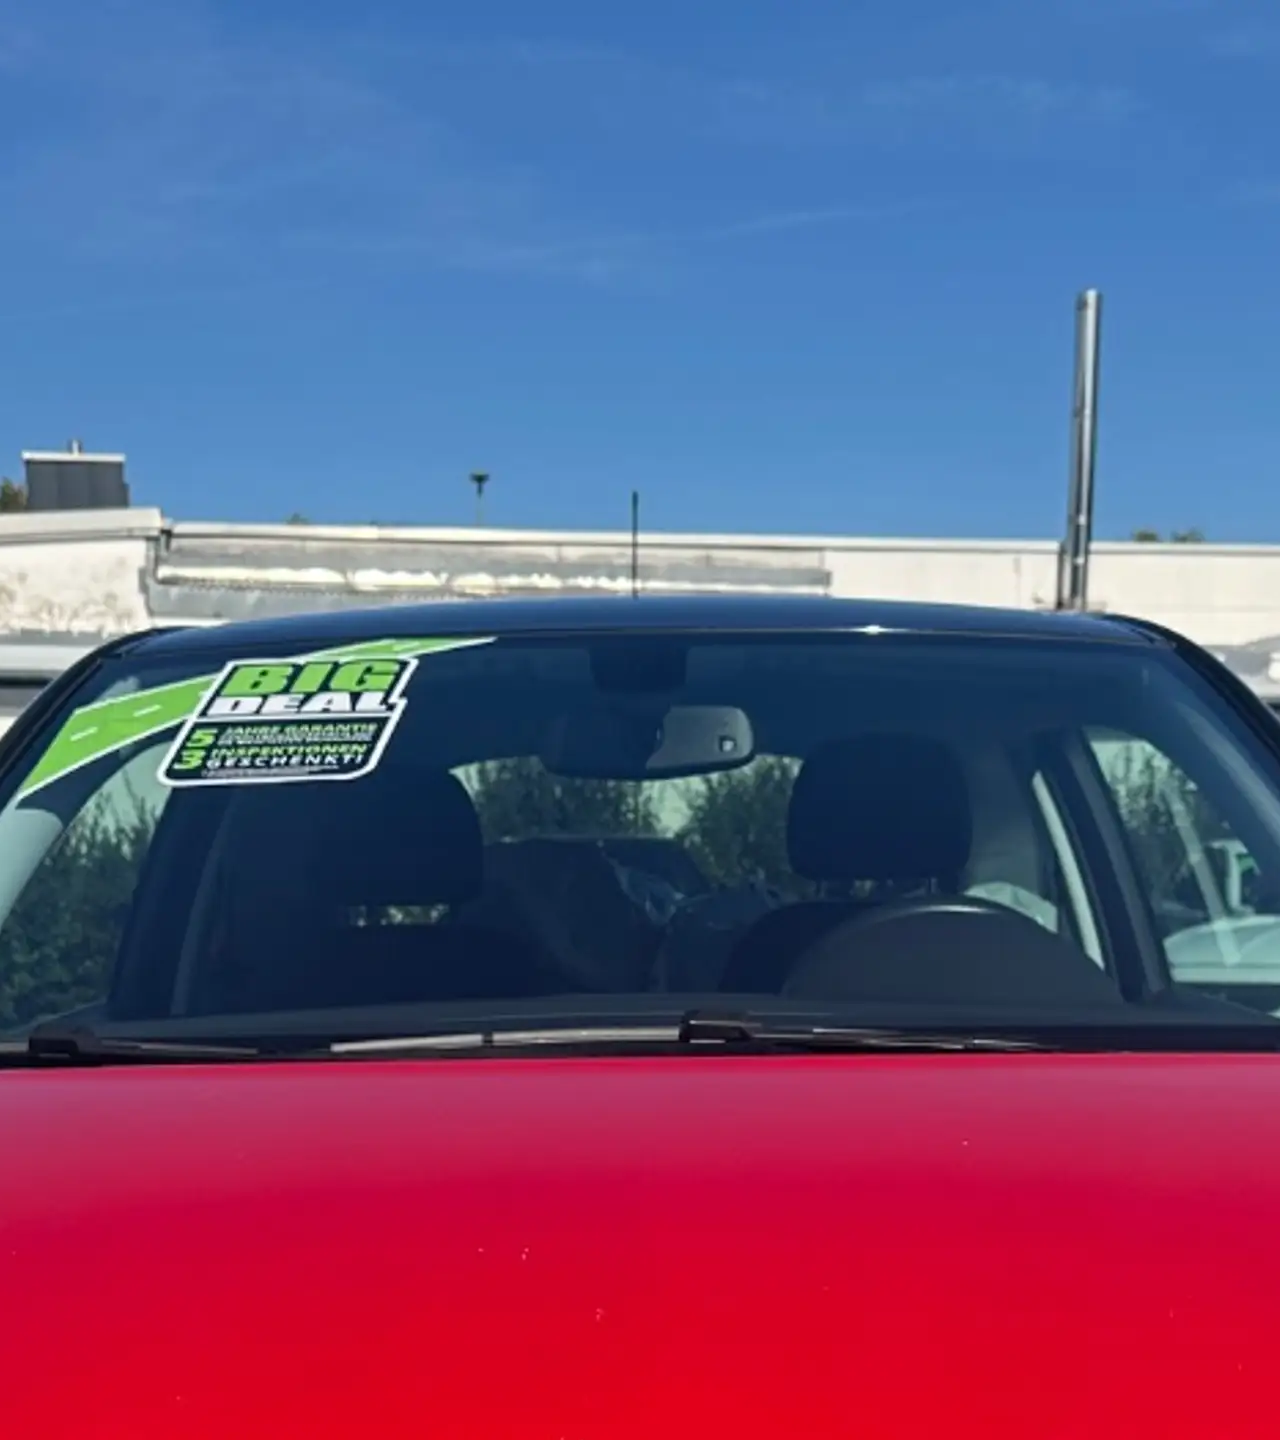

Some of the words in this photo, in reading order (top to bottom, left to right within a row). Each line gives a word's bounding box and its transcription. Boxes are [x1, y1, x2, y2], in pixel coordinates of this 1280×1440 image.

[222, 660, 400, 695] BIG
[207, 691, 392, 715] DEAL
[185, 729, 219, 748] 5
[283, 723, 377, 734] GARANTIE
[172, 749, 206, 769] 3
[210, 744, 367, 759] INSPEKTIONEN
